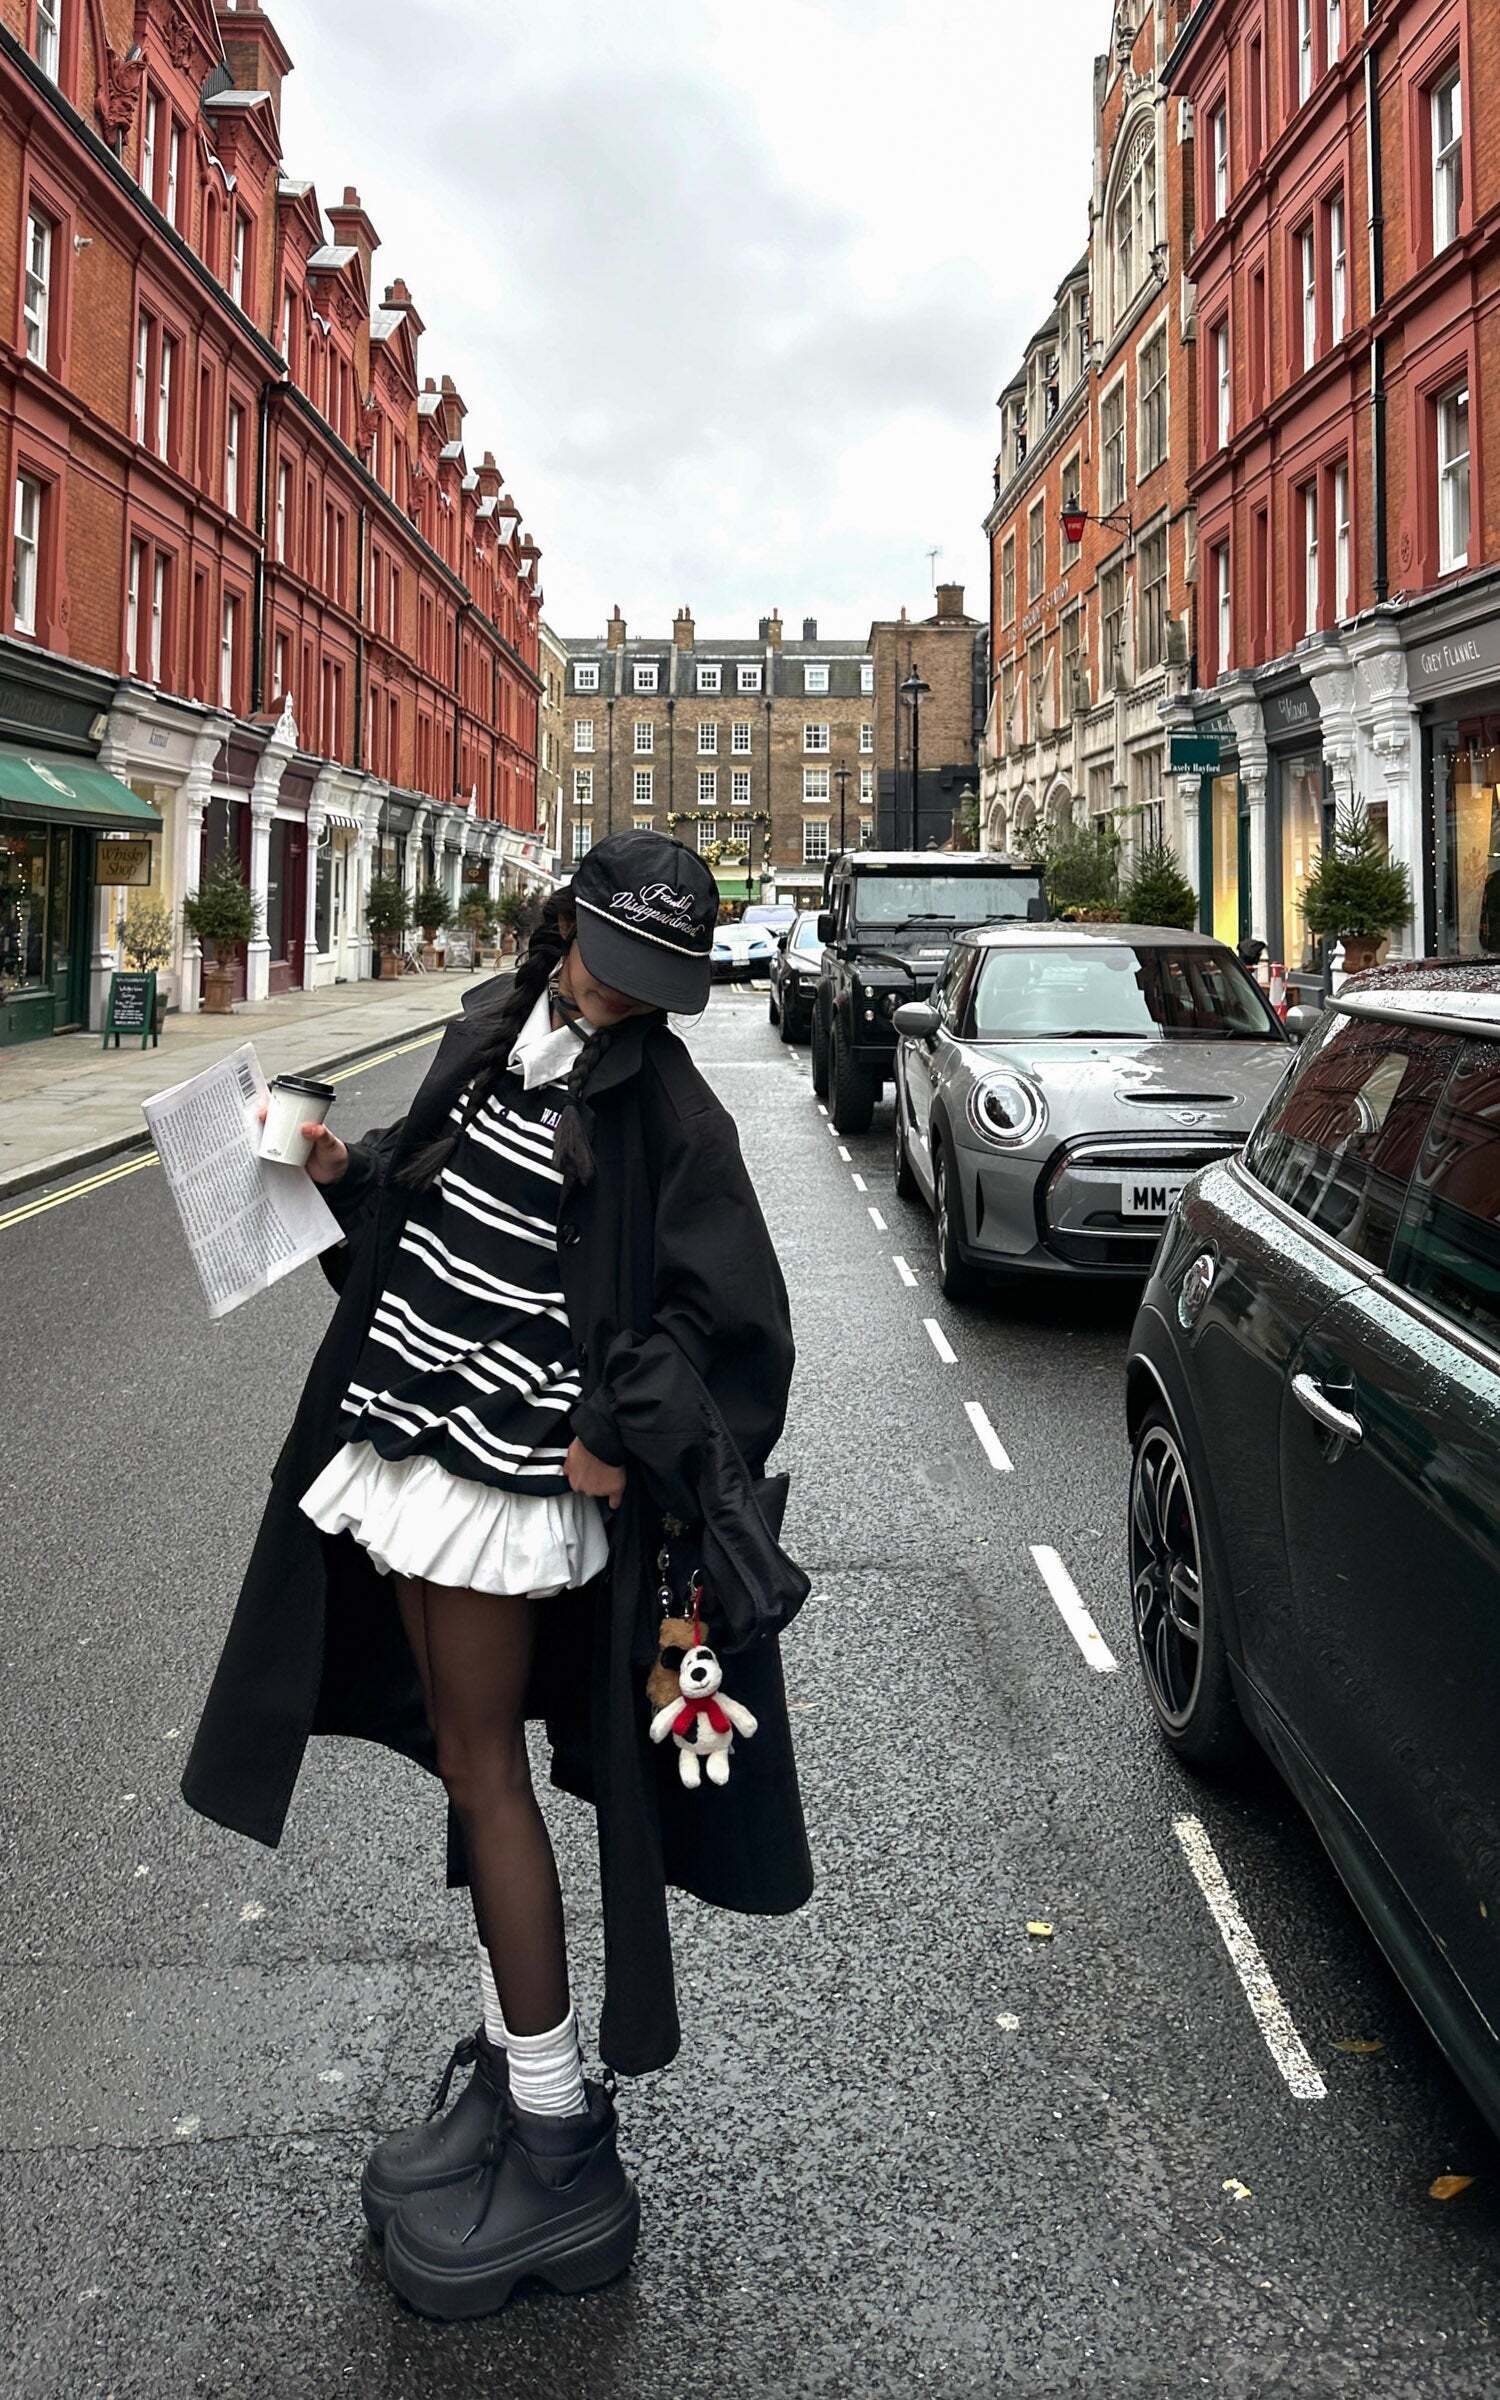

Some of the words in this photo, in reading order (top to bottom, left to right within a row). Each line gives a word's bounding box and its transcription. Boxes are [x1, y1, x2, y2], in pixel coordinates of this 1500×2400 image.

[1421, 652, 1442, 675] GREY
[1443, 641, 1481, 668] FLANNEL
[102, 847, 147, 866] Whisky
[106, 862, 138, 880] Shop
[639, 883, 695, 916] Family
